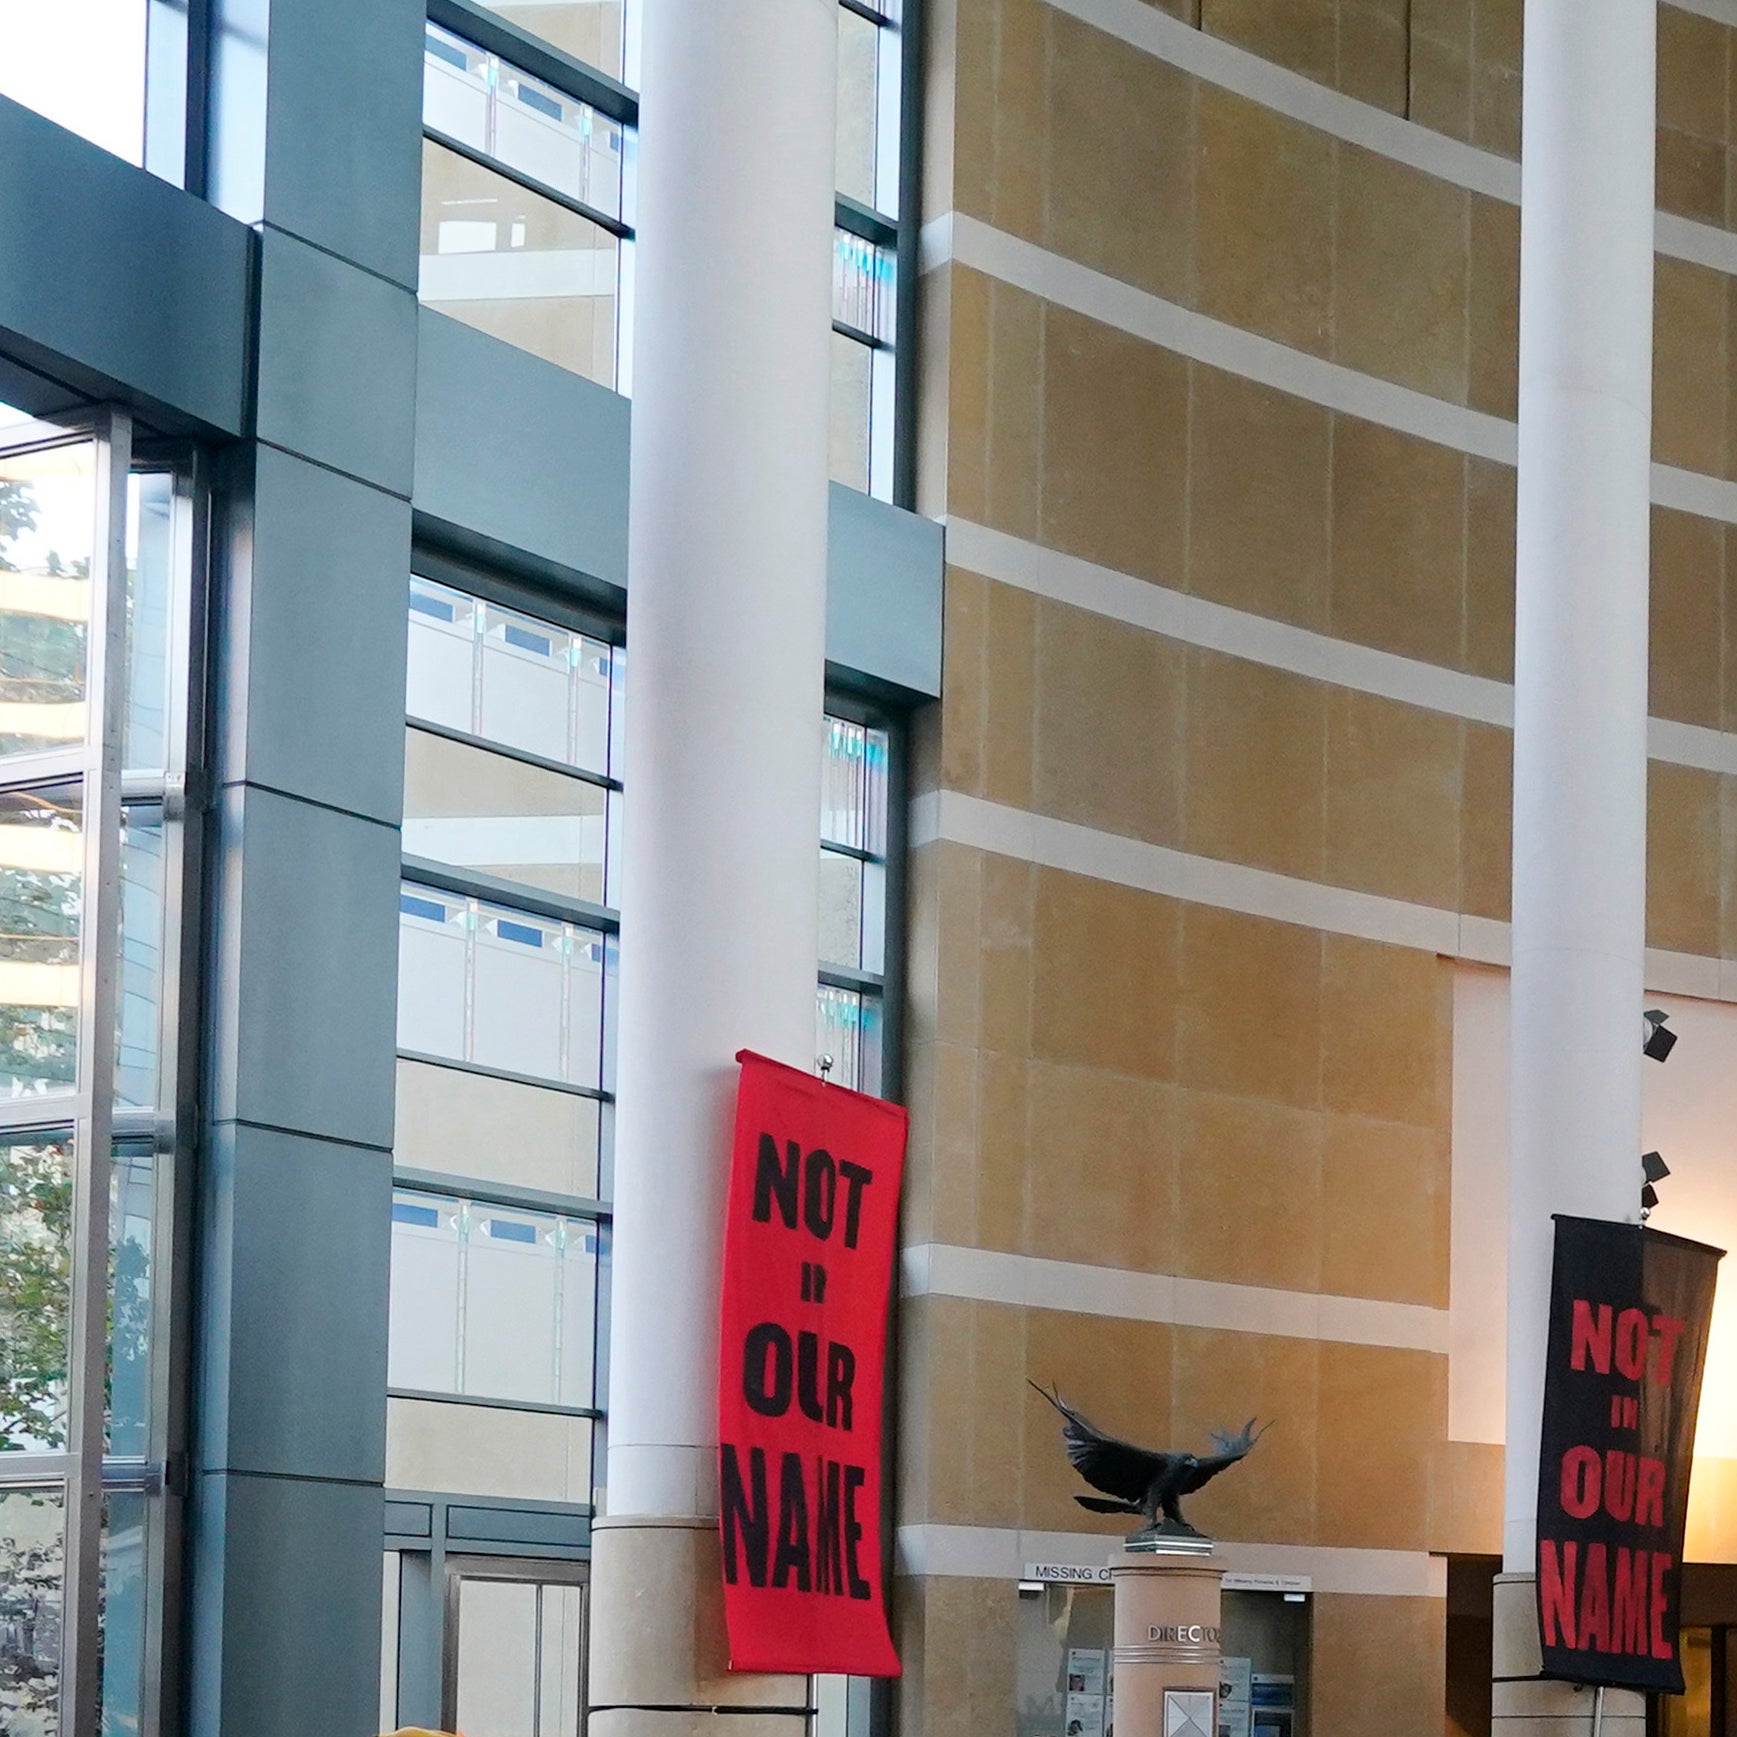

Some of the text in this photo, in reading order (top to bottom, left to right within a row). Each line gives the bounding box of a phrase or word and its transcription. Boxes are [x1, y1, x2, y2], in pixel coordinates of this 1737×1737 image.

[752, 1132, 873, 1249] NOT
[1570, 1299, 1686, 1386] NOT
[1610, 1395, 1638, 1429] IN
[1560, 1445, 1666, 1528] OUR
[1035, 1565, 1093, 1580] MISSING
[1540, 1539, 1673, 1660] NAME
